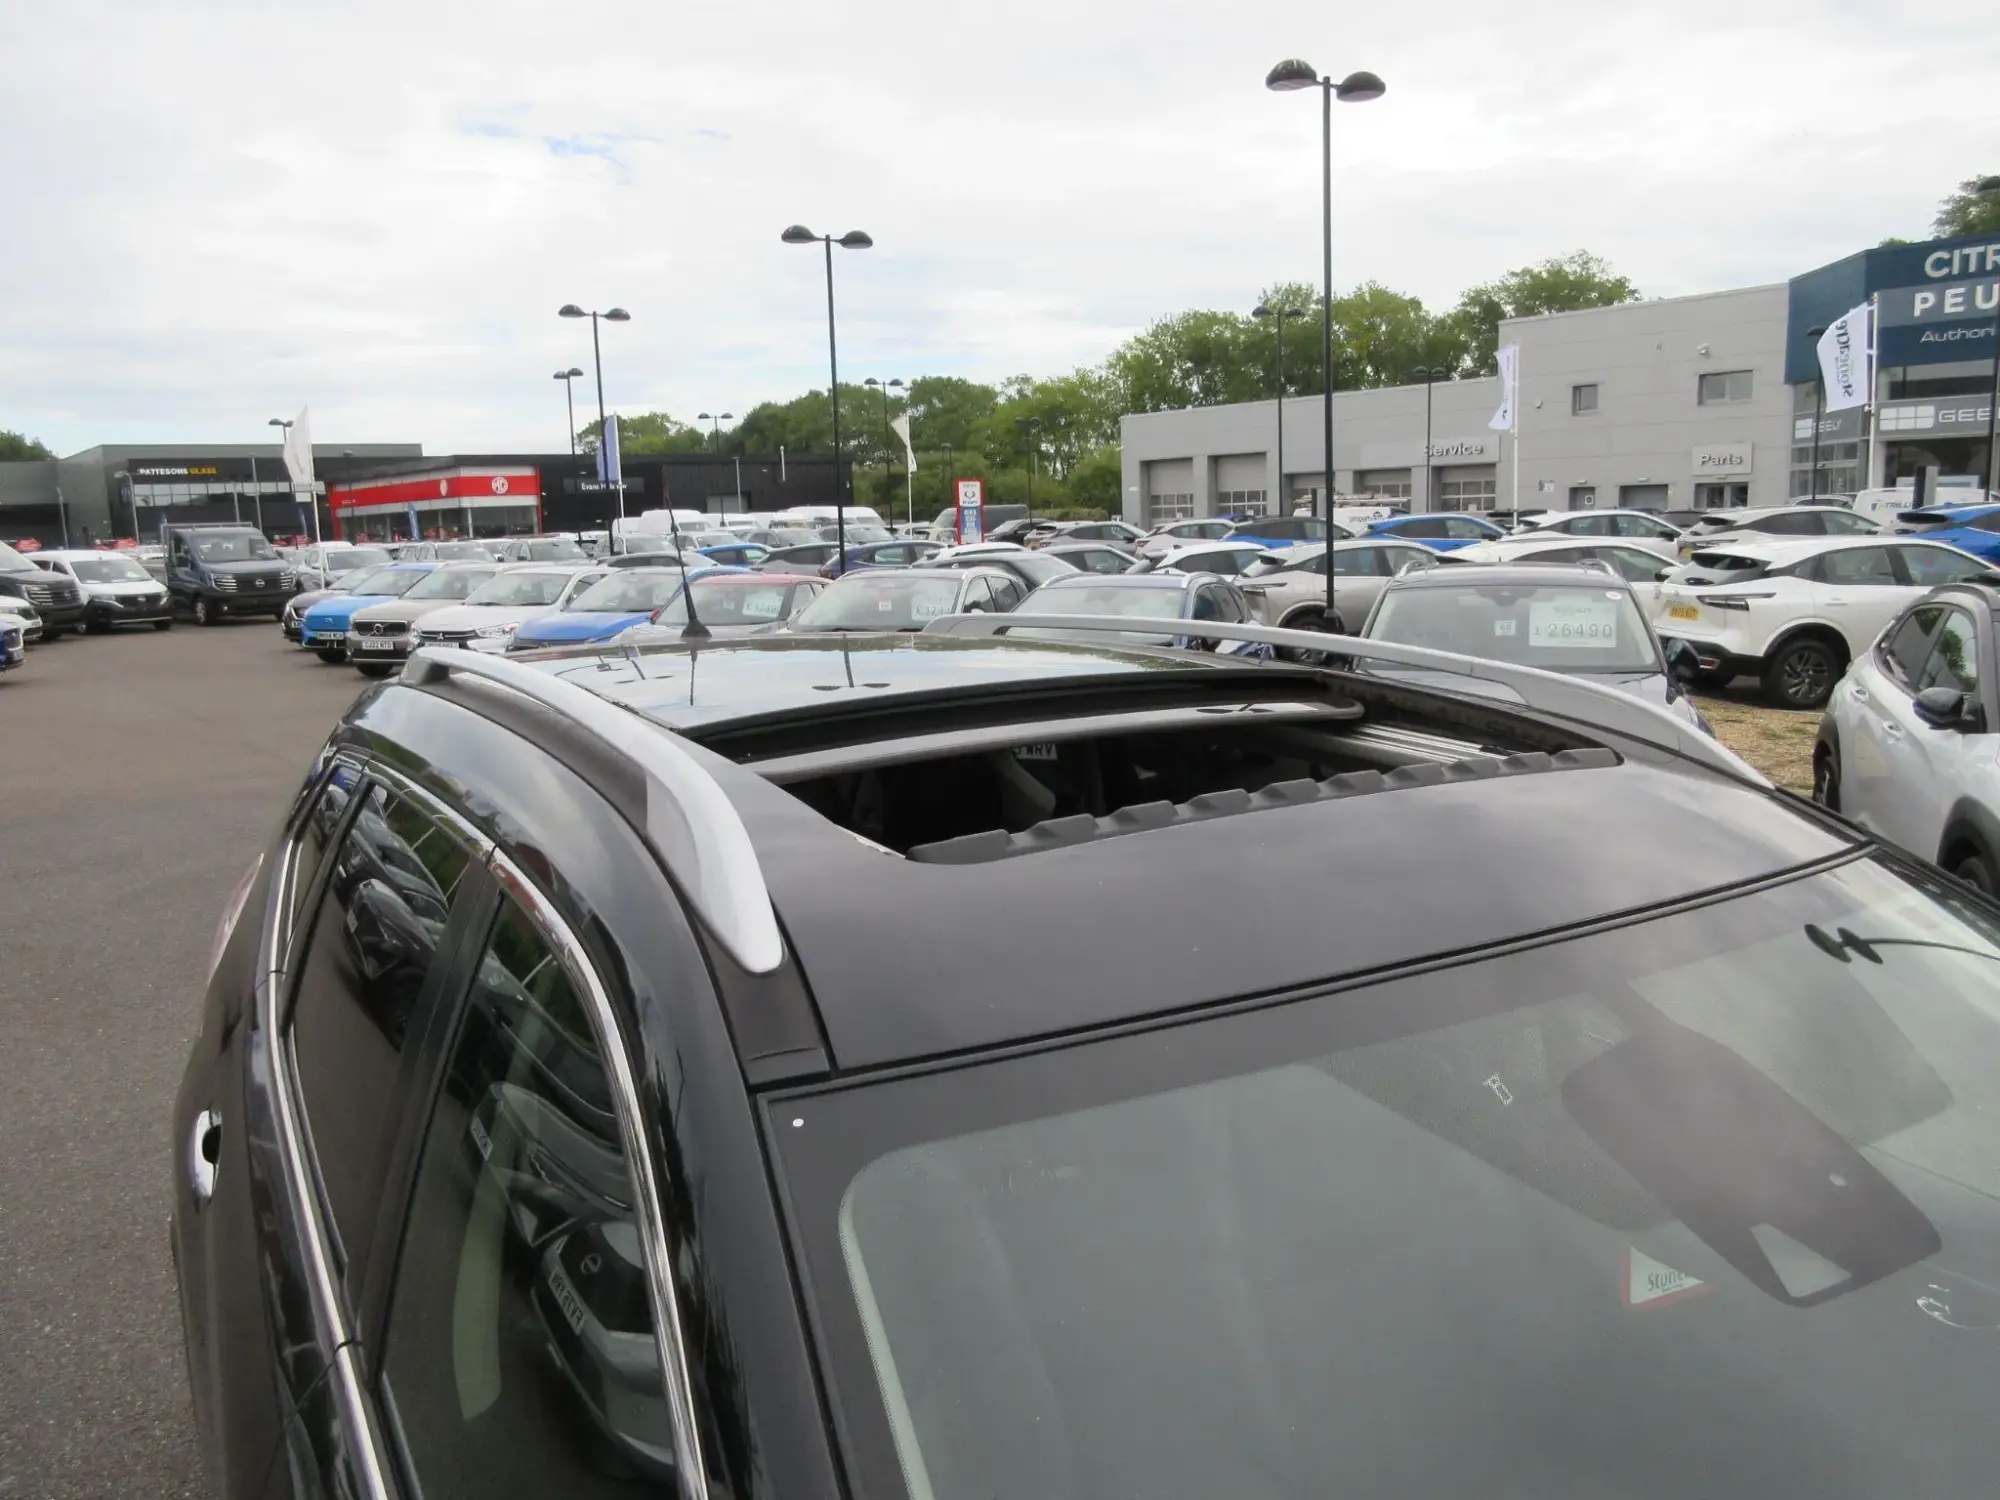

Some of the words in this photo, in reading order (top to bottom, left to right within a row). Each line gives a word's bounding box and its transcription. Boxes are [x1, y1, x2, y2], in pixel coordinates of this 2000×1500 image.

[1424, 442, 1484, 458] Service
[1699, 453, 1744, 467] Parts
[581, 482, 599, 491] Evans
